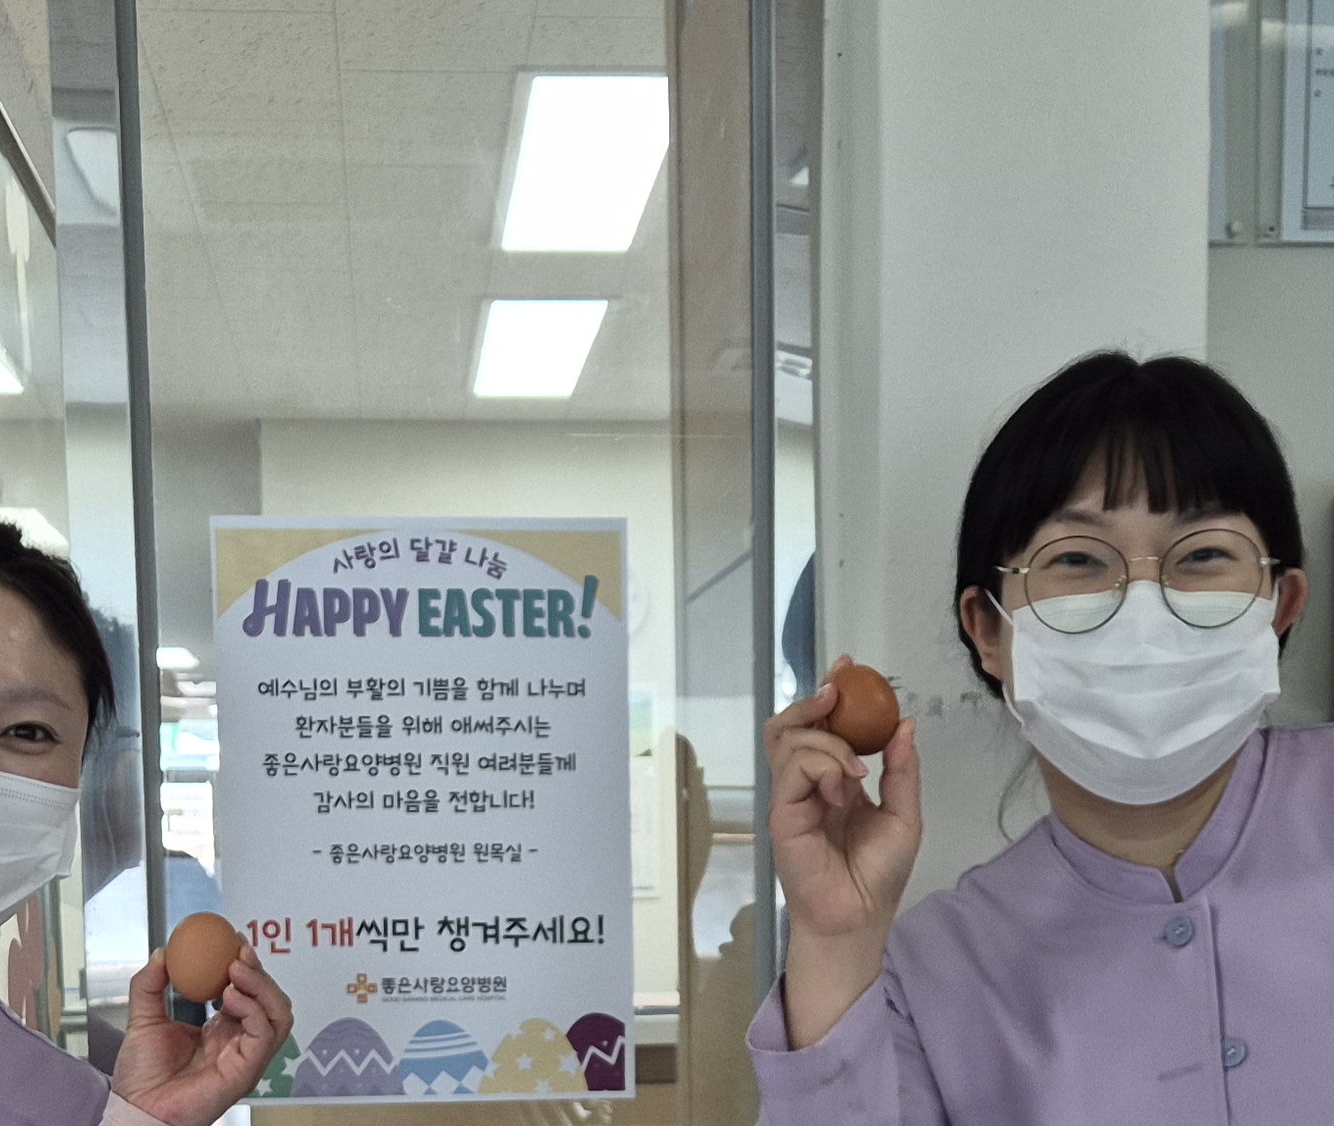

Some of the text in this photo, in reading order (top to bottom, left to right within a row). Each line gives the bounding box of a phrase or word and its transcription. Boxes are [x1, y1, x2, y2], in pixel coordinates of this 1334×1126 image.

[332, 537, 508, 580] 사랑의 달걀 나눔
[242, 575, 599, 639] HAPPY EASTER!
[257, 677, 586, 700] 예수님의 부활의 기쁨을 함께 나누며
[295, 714, 551, 739] 환자분들을 위해 애써주시는
[263, 752, 577, 778] 좋은사랑요양병원 직원 여러분들께
[314, 790, 535, 814] 감사의 마음을 전합니다!
[329, 844, 465, 864] 좋은사랑요양병원
[473, 843, 522, 863] 원목실
[247, 914, 605, 954] 1인 1개씩만 챙겨주세요!
[381, 975, 508, 995] 좋은사랑요양병원
